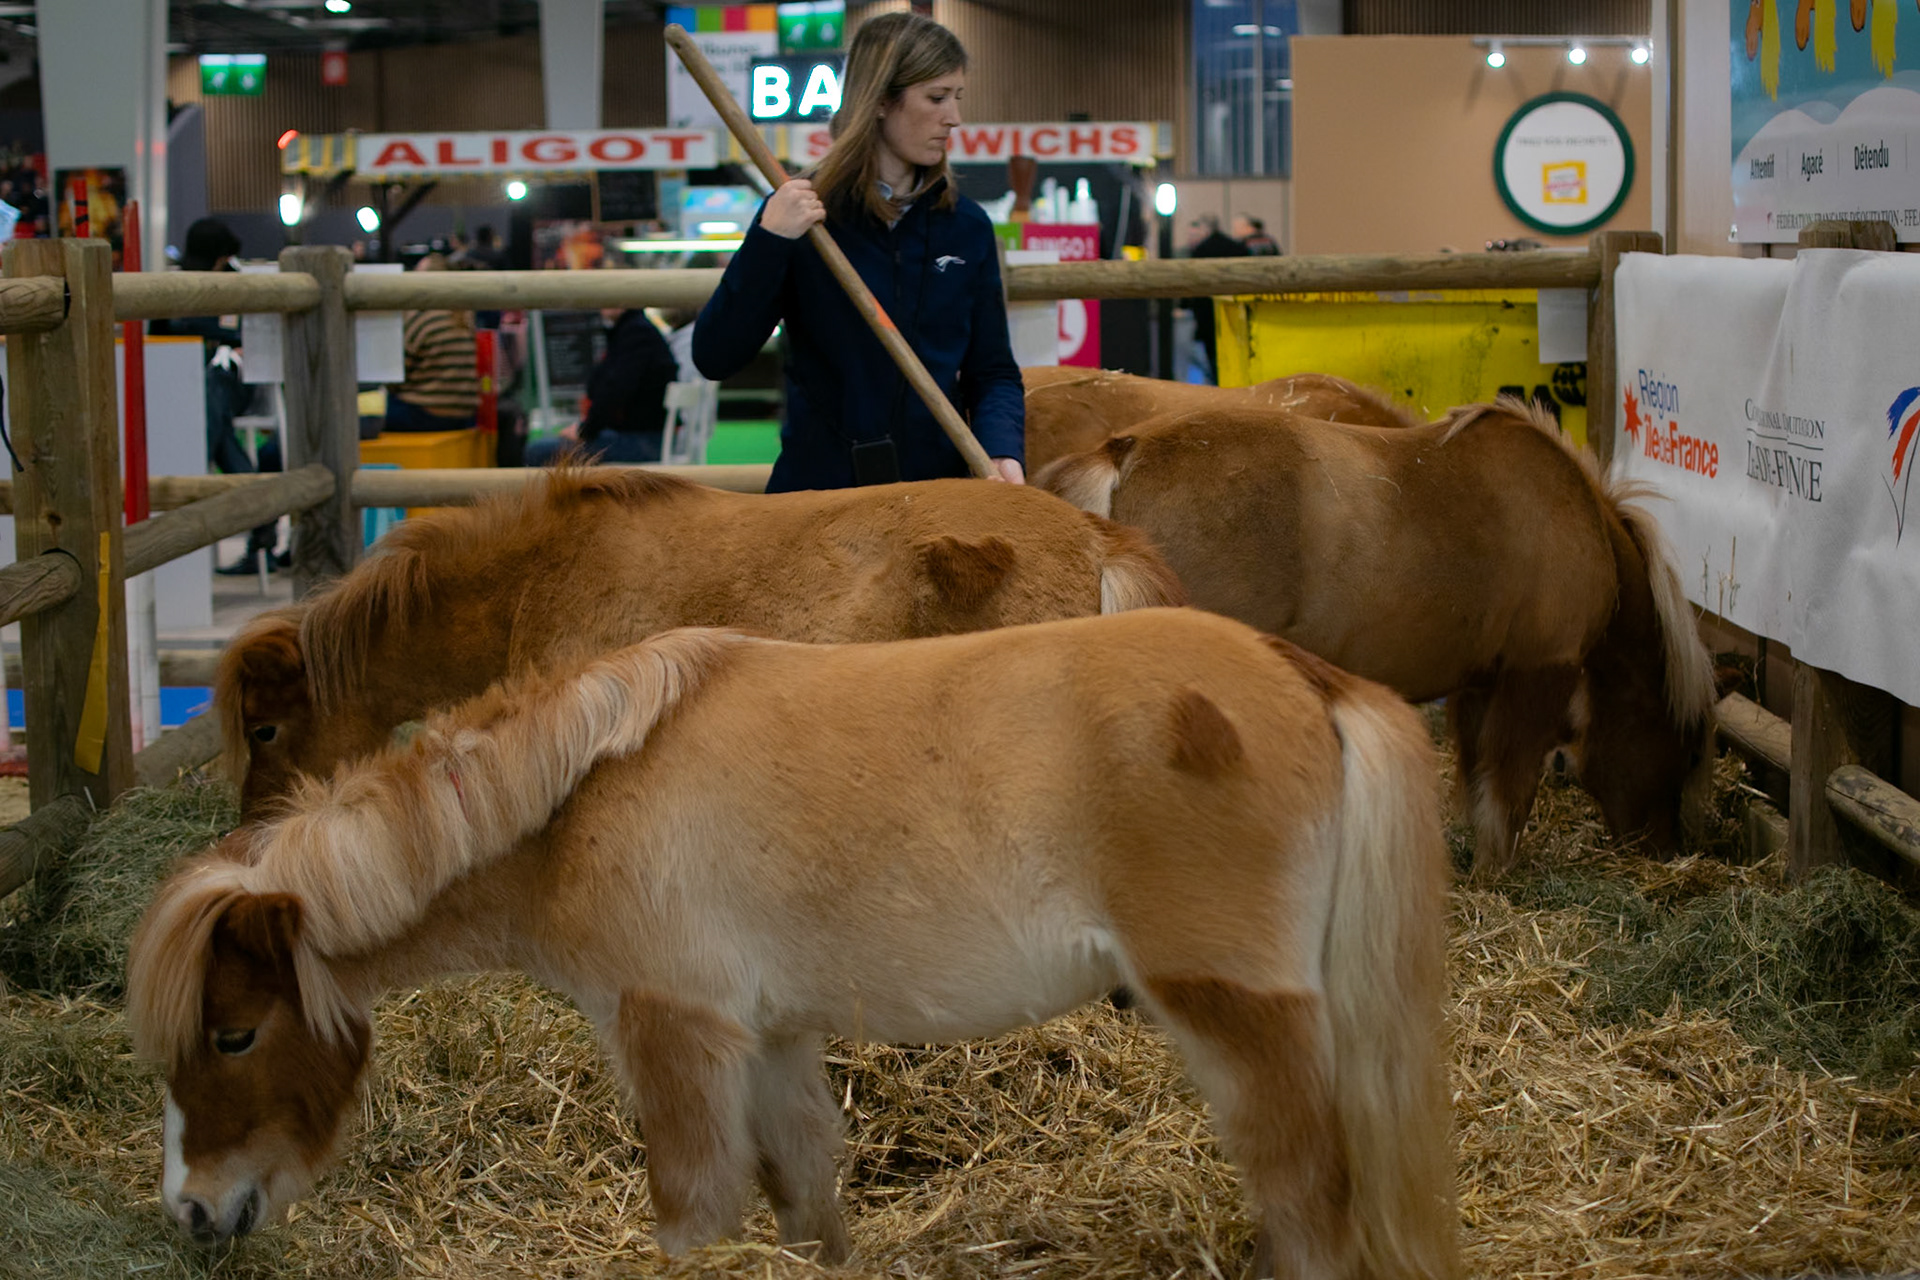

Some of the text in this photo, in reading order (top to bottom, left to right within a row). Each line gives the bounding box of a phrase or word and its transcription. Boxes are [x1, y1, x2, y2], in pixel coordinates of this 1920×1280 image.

[752, 64, 842, 118] BA
[371, 135, 704, 168] ALIGOT
[806, 126, 1140, 160] SWICHS
[1750, 139, 1889, 181] Attentif Agacé Détendu
[1638, 368, 1679, 420] Région
